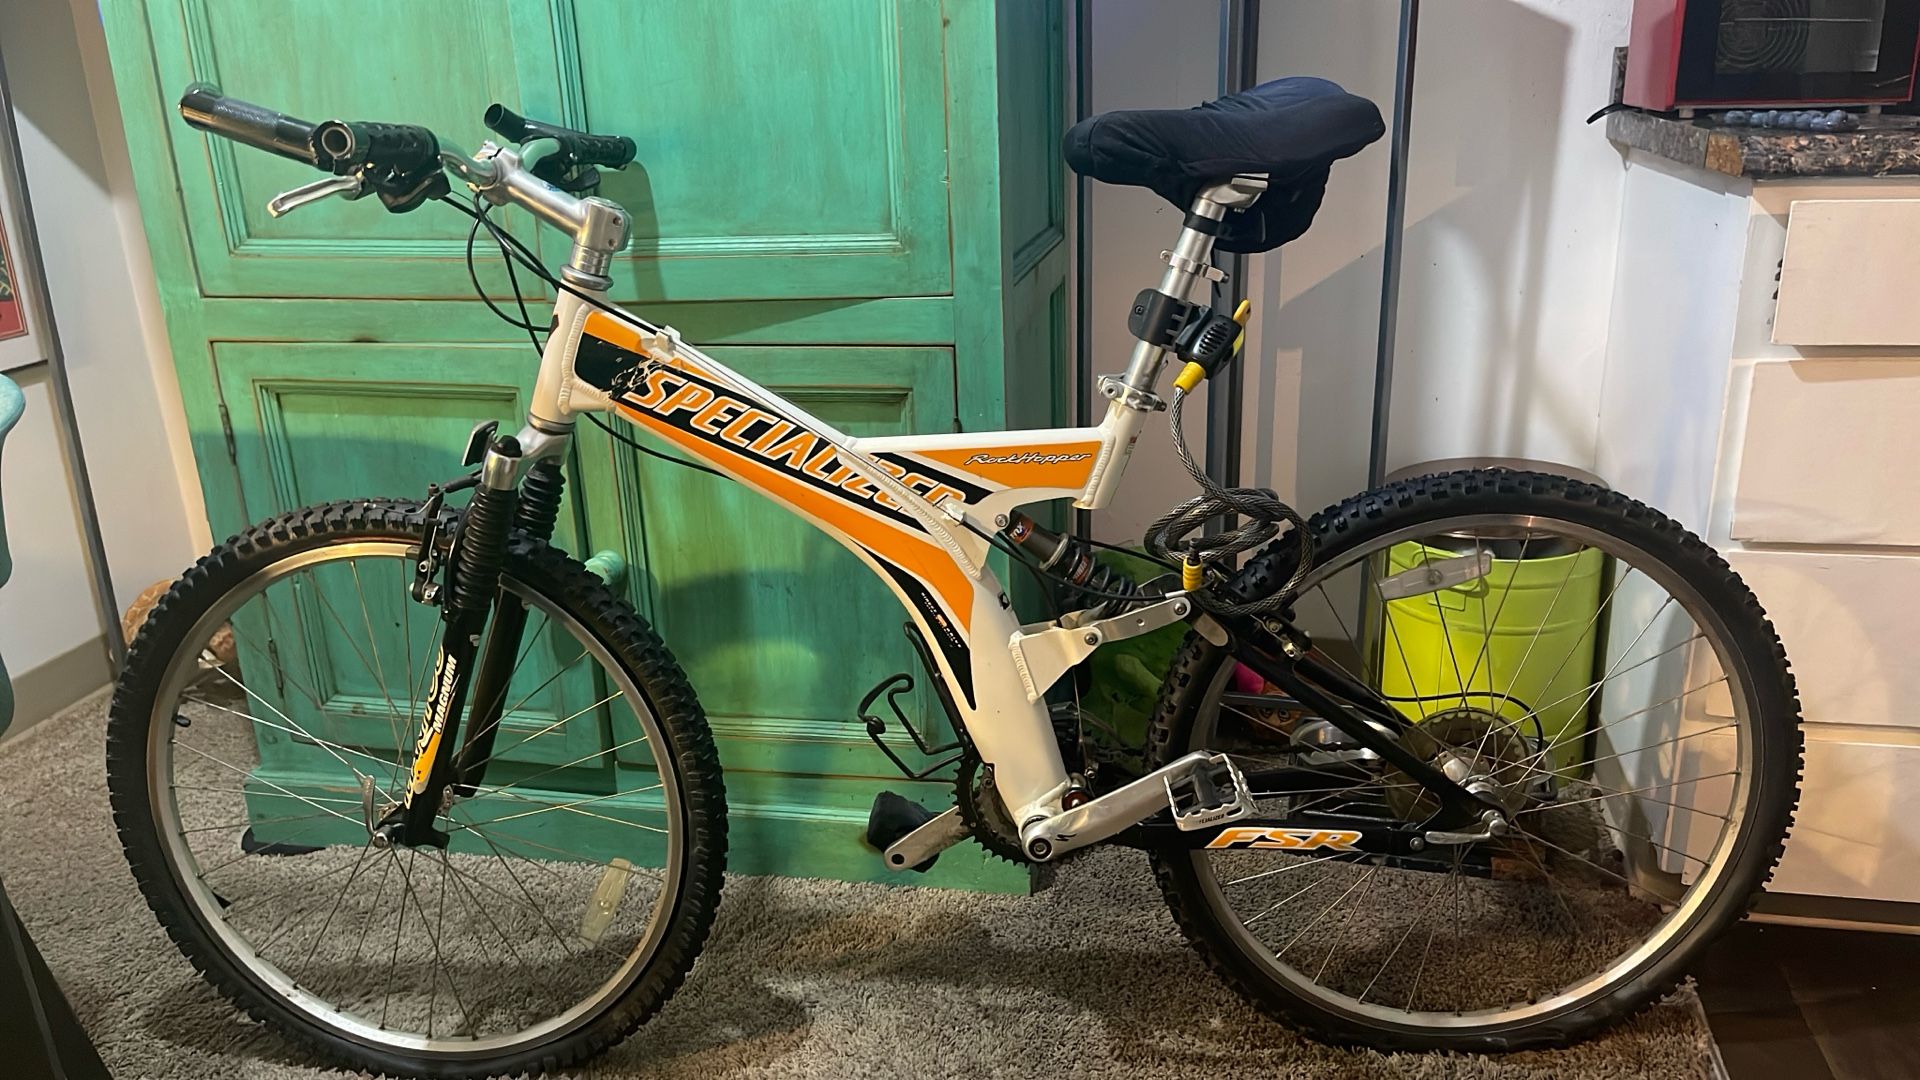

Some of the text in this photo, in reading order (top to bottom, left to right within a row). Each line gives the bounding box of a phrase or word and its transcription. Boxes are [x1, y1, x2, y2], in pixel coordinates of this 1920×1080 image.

[964, 452, 1093, 466] RockHopper
[432, 653, 458, 735] MAGNUM
[1204, 826, 1364, 852] FSR
